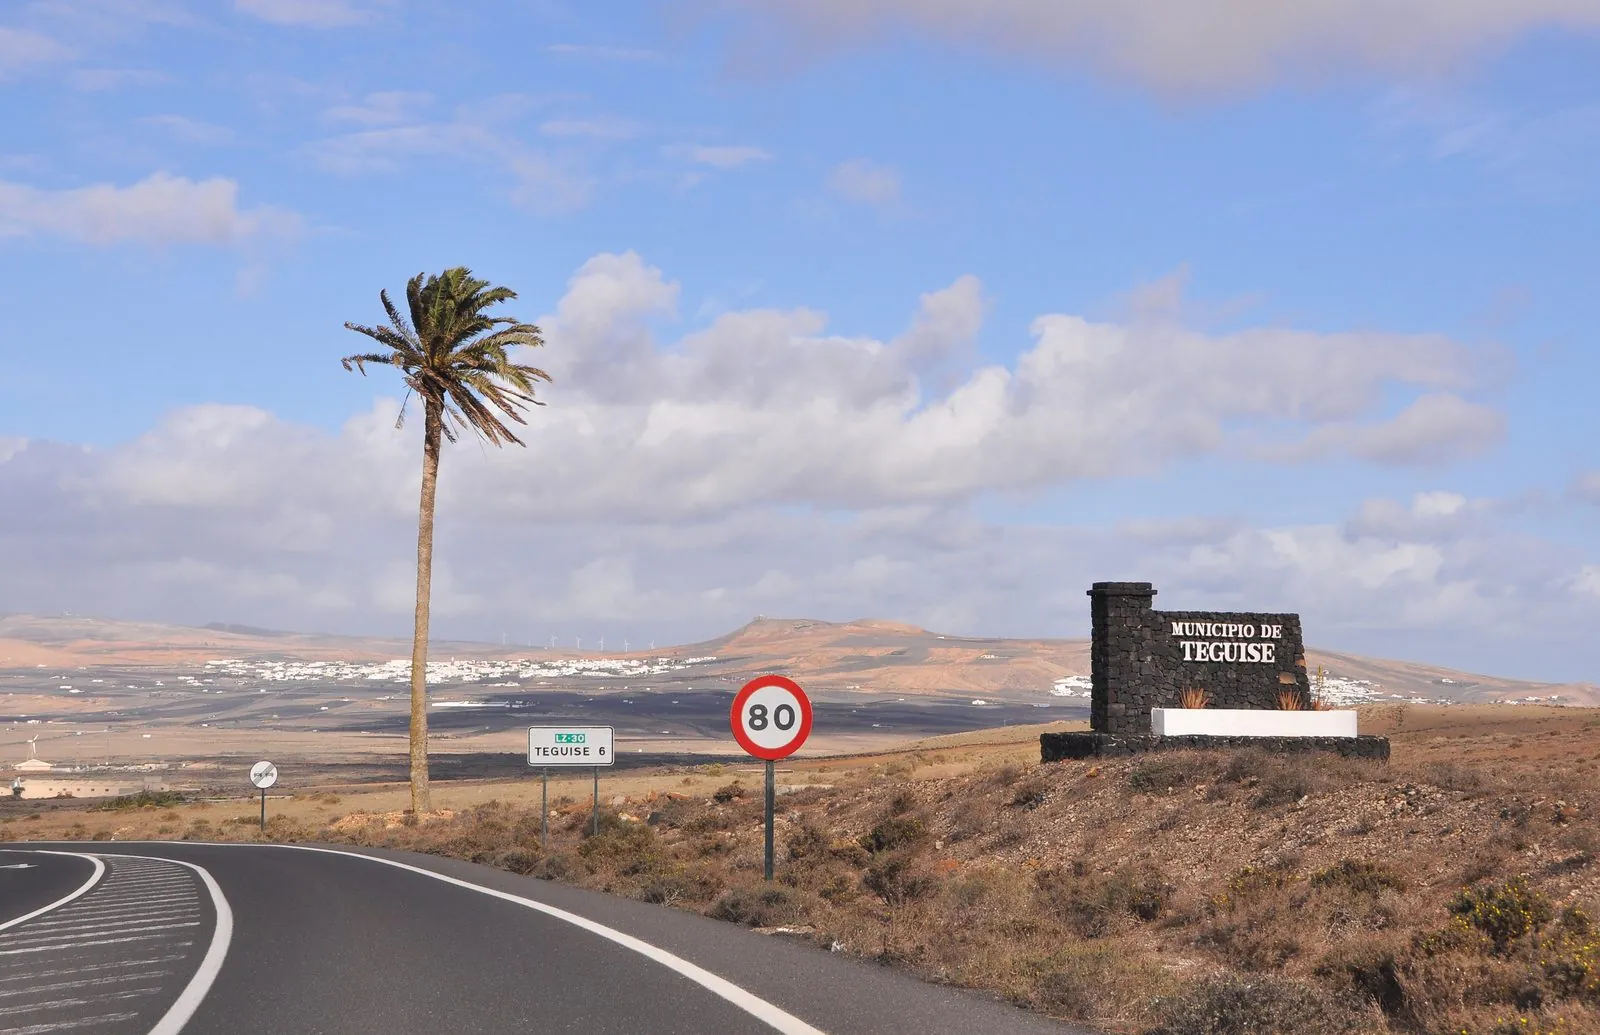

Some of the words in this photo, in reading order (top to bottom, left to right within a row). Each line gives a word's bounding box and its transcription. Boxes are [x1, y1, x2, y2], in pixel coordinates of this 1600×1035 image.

[1171, 621, 1255, 638] MUNICIPIO
[1260, 624, 1282, 639] DE
[1180, 641, 1275, 663] TEGUISE
[748, 704, 795, 731] 80
[555, 734, 585, 743] LZ-30
[535, 746, 590, 756] TEGUISE
[598, 746, 606, 756] 6
